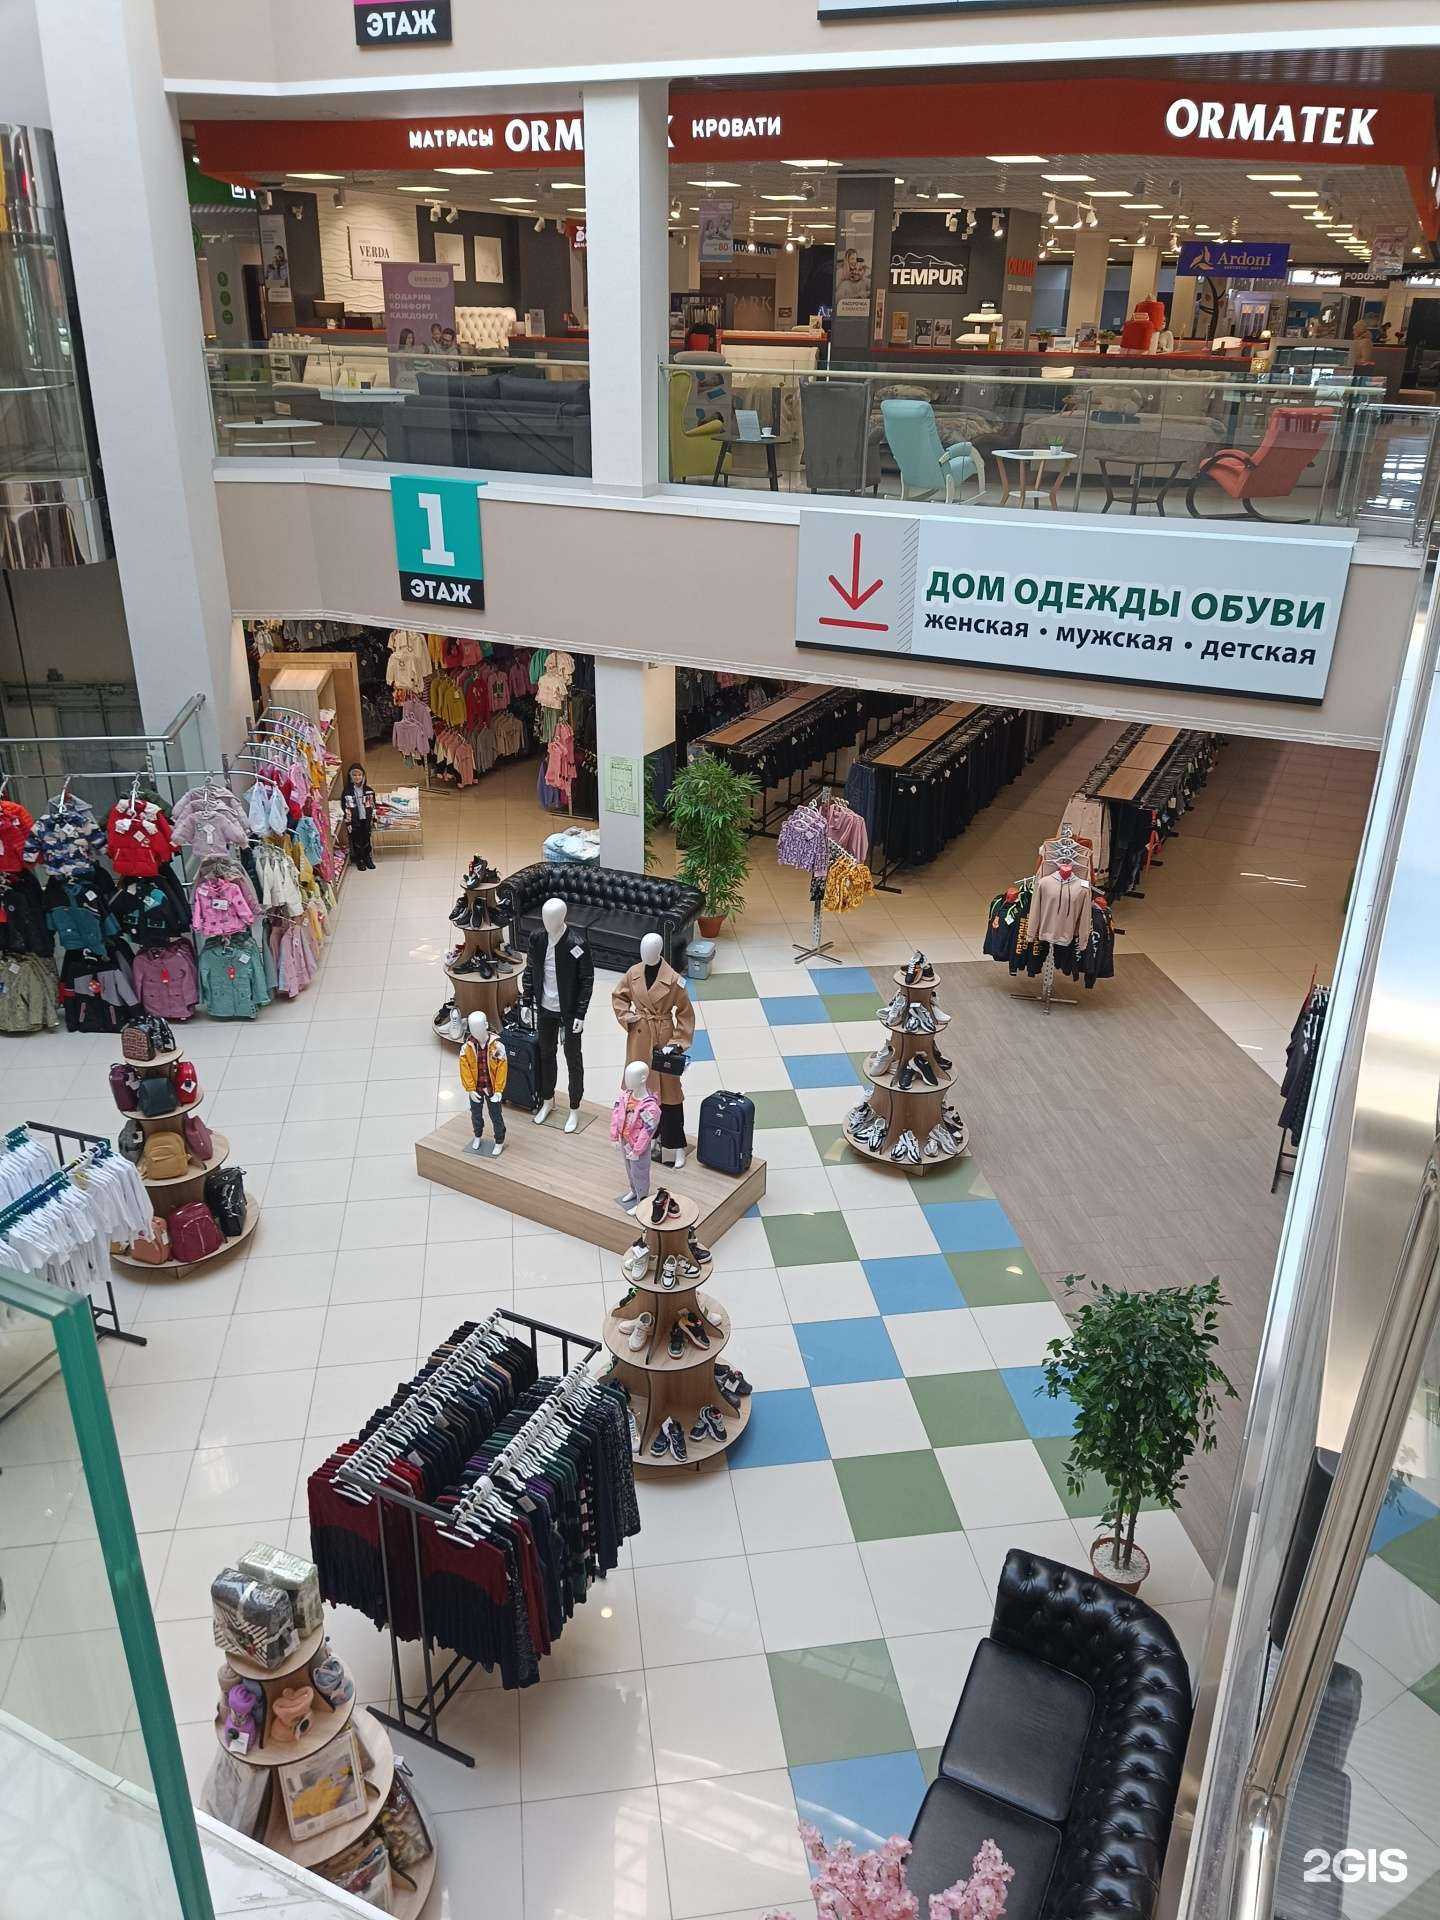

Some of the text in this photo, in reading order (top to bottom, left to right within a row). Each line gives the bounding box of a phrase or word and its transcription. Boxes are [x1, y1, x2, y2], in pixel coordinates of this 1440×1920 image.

[366, 8, 437, 37] ЭТАЖ
[408, 128, 494, 149] МАТРАСЫ
[691, 116, 781, 138] КРОВАТИ
[1165, 98, 1379, 146] ORMATEK
[359, 245, 390, 259] VERDA
[1216, 251, 1272, 266] Ardoni
[890, 268, 963, 286] TEMPUR
[389, 303, 432, 311] КОМФОРТ
[418, 492, 455, 567] 1
[410, 578, 472, 604] ЭТАЖ
[926, 570, 1326, 630] ДОМ ОДЕЖДЫ ОБУВИ
[924, 612, 1317, 666] женская мужская детская
